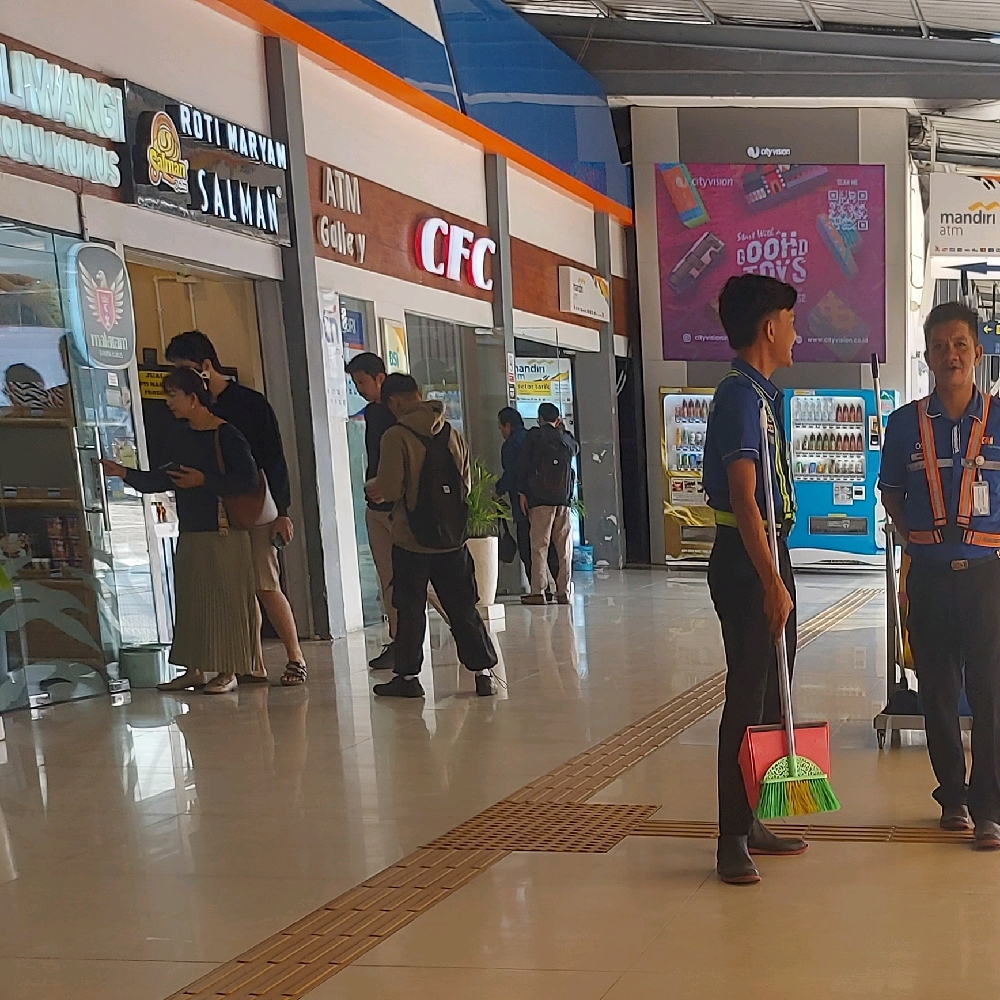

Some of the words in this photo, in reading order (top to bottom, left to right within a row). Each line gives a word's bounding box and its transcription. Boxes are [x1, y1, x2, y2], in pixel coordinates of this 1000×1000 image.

[179, 104, 222, 147] ROTI
[227, 122, 287, 170] MARYAM
[197, 168, 280, 235] SALMAN
[322, 164, 362, 215] ATM
[940, 210, 996, 225] mandiri
[415, 217, 496, 291] CFC
[940, 226, 963, 237] atm
